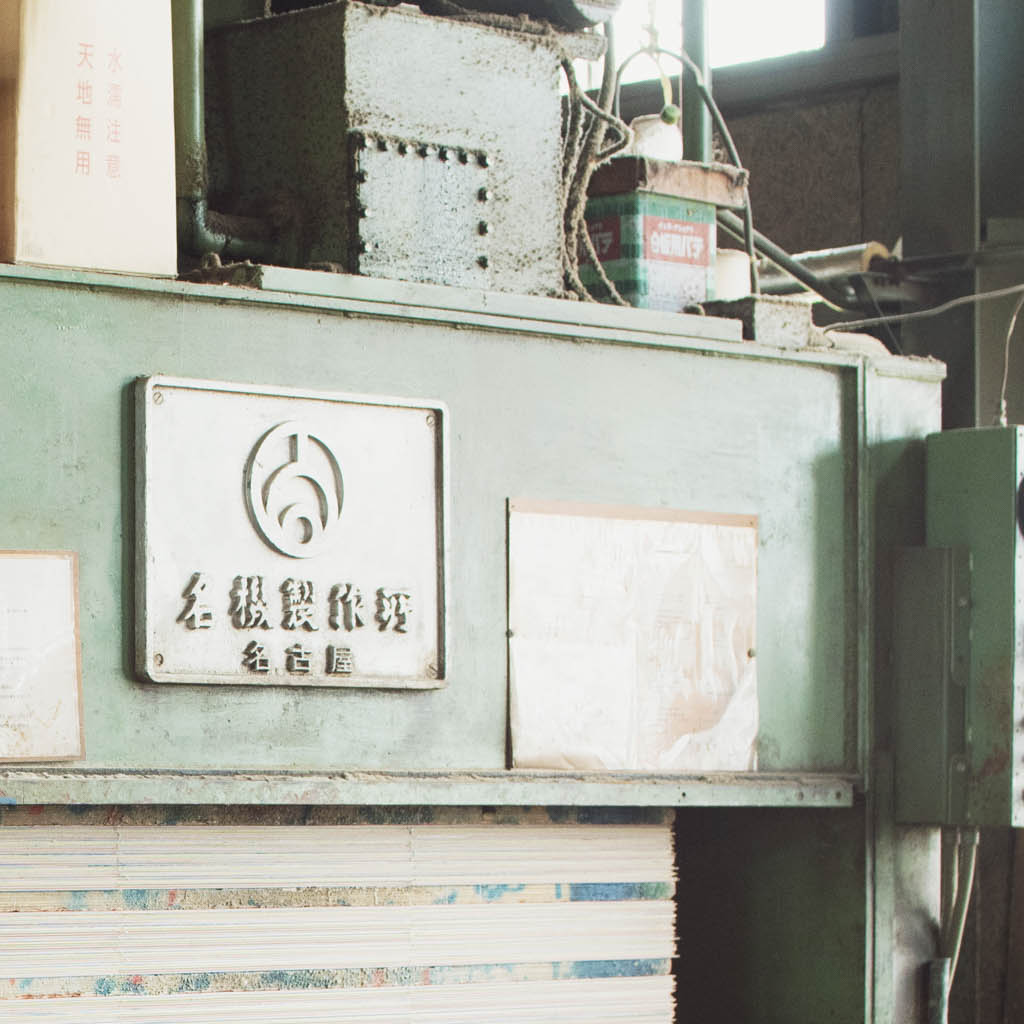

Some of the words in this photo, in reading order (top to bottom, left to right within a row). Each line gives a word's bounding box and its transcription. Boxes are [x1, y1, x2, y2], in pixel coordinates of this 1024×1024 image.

[75, 41, 95, 177] 天地無用
[242, 640, 353, 674] 名古屋
